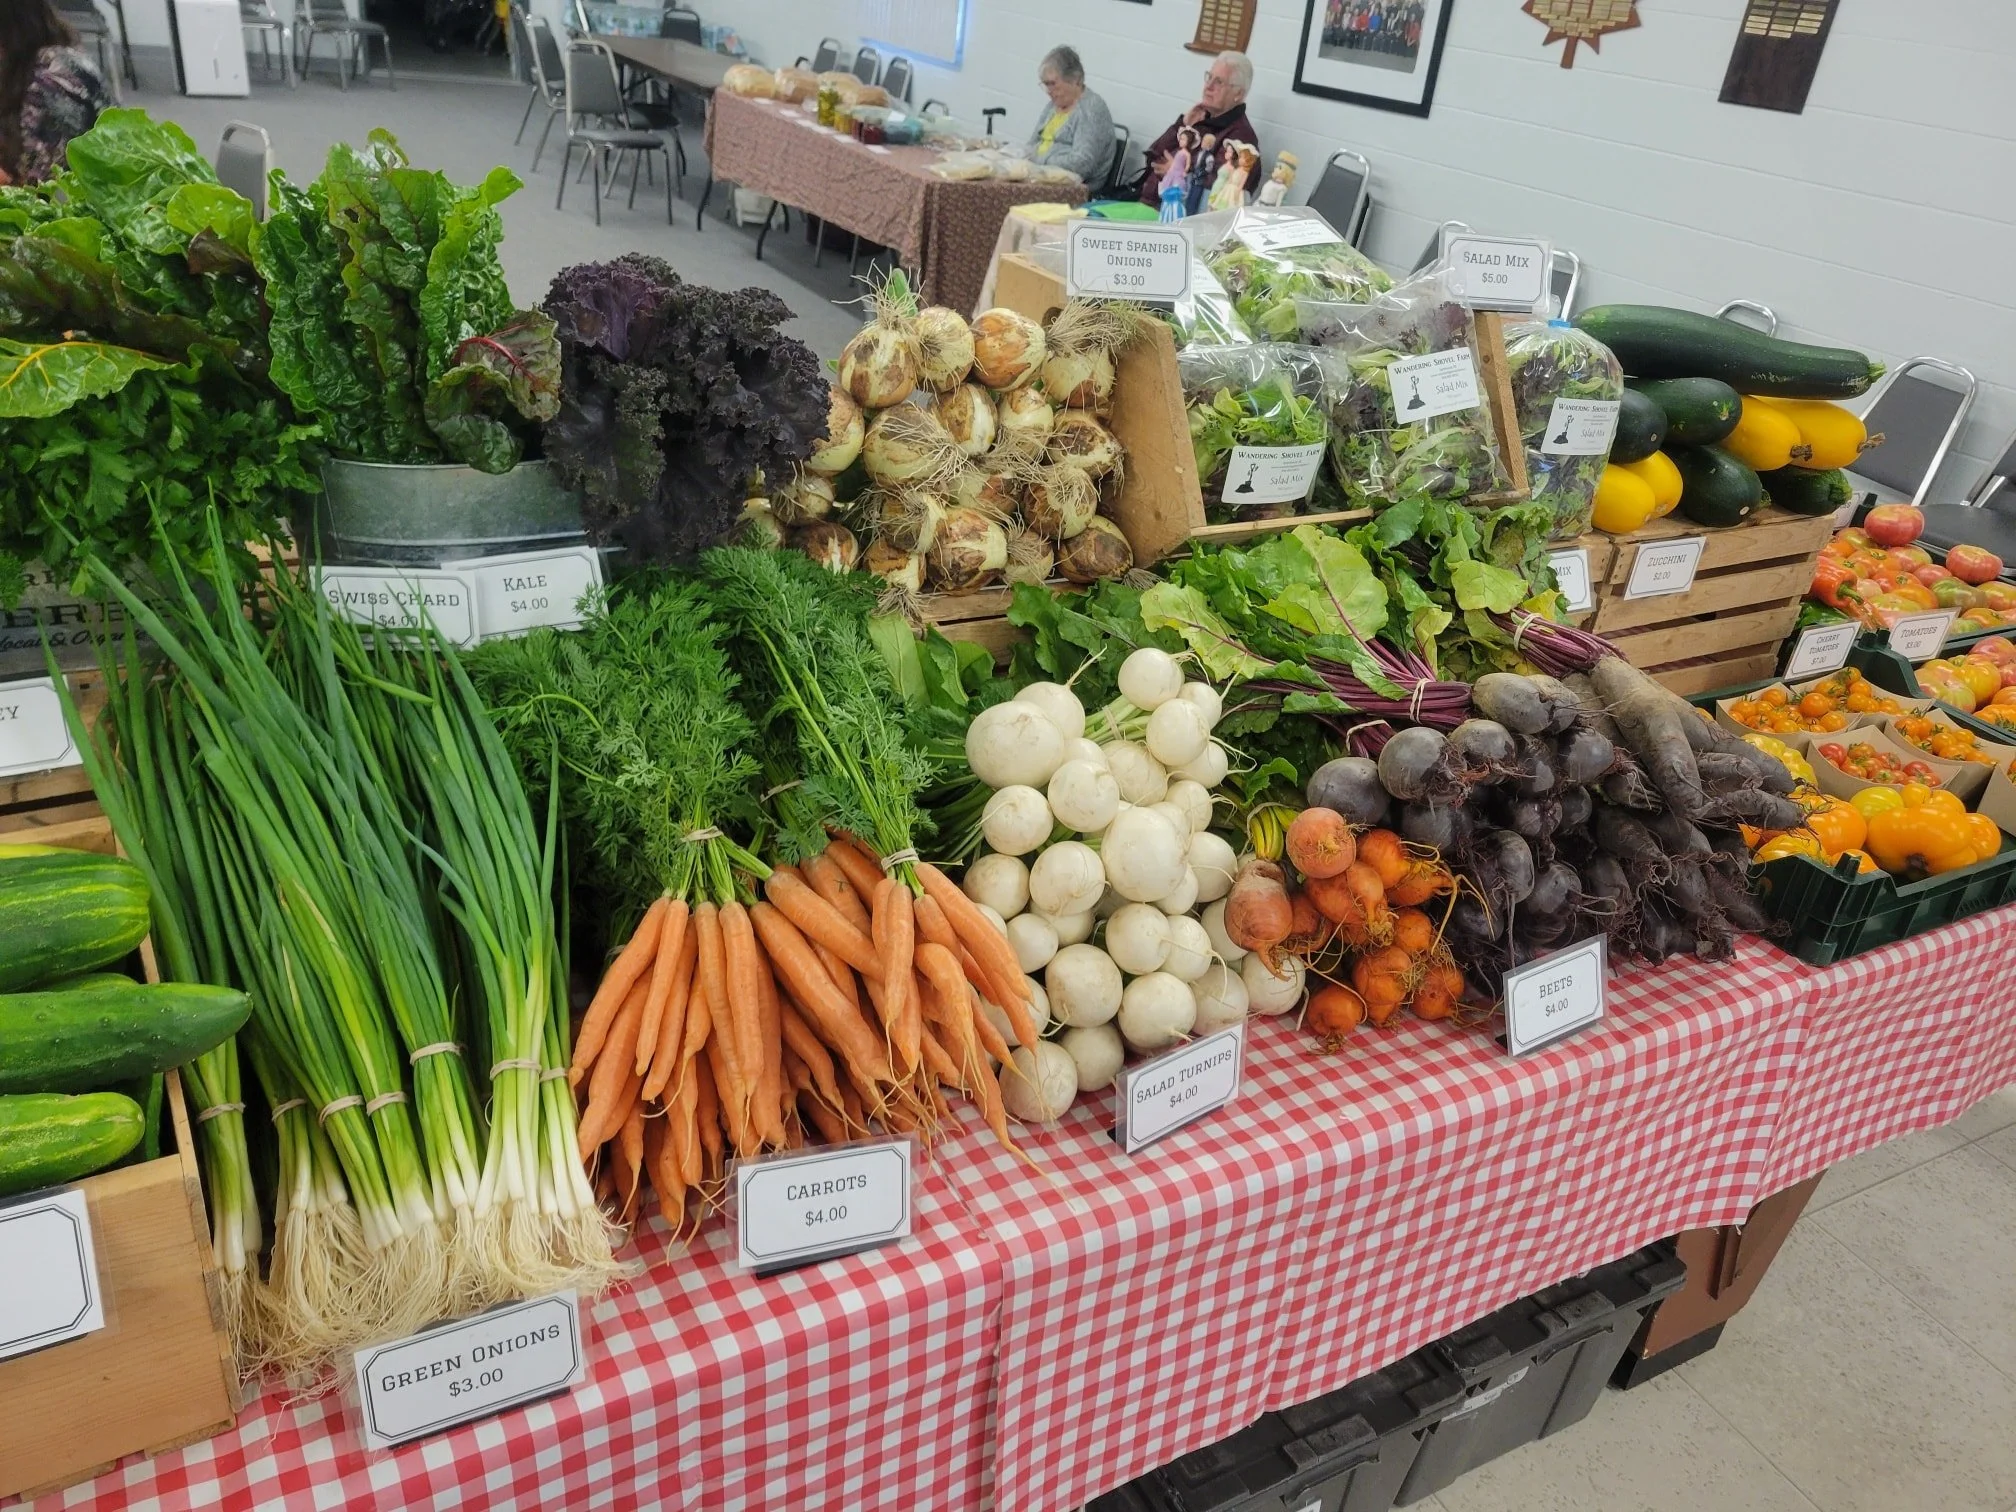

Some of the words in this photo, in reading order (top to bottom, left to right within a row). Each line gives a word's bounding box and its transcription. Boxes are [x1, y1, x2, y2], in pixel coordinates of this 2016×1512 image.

[1082, 238, 1123, 250] SWEET
[1126, 240, 1178, 254] SPANISH
[1107, 255, 1153, 267] ONIONS
[1463, 251, 1500, 266] SALAD
[1506, 254, 1530, 268] MIX
[1114, 274, 1145, 287] $3.00
[1481, 272, 1508, 284] $5.00
[1394, 361, 1432, 375] WANDERING
[1434, 358, 1455, 366] SHOVEL
[1435, 382, 1454, 394] Salad
[1455, 380, 1468, 390] Mix
[1238, 451, 1278, 459] WANDERING
[1648, 554, 1687, 567] ZUCCHINI
[503, 575, 548, 592] KALE
[1653, 571, 1670, 581] $2.00
[328, 590, 389, 605] SWISS
[396, 592, 460, 606] CHARD
[510, 598, 549, 612] $4.00
[378, 614, 418, 627] $4.00
[1816, 634, 1840, 644] CHERRY
[1901, 626, 1938, 638] TOMATOES
[1810, 644, 1840, 654] TOMATOES
[1539, 975, 1573, 999] BEETS
[1545, 998, 1568, 1017] $4.00
[1136, 1076, 1175, 1104] SALAD
[1179, 1050, 1232, 1083] TURNIPS
[1169, 1085, 1198, 1108] $4.00
[787, 1174, 867, 1201] CARROTS
[805, 1206, 848, 1227] $4.00
[382, 1355, 462, 1392] GREEN
[472, 1324, 561, 1363] ONIONS
[449, 1368, 504, 1397] $3.00
